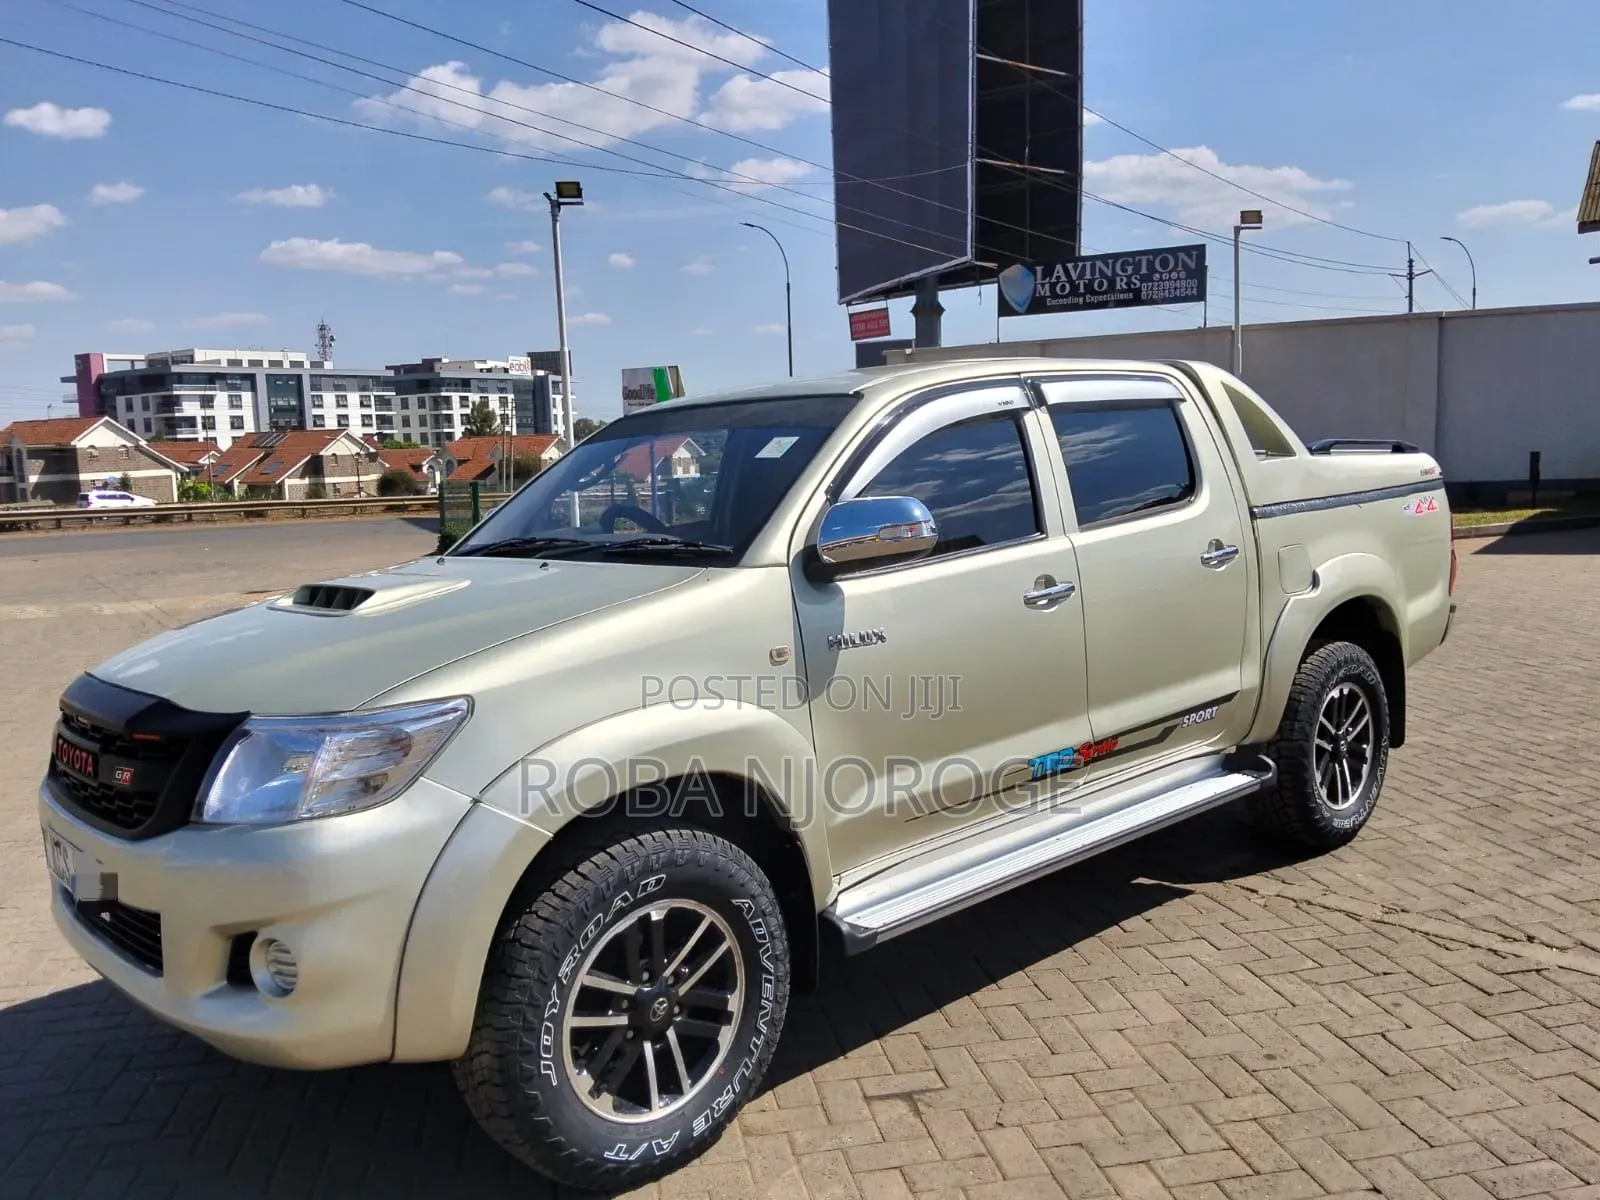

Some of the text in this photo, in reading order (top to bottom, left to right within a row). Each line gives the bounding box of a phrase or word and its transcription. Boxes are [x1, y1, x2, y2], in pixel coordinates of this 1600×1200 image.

[1035, 252, 1198, 284] LAVINGTON
[1036, 275, 1141, 296] MOTORS
[827, 629, 887, 651] HILUX
[1182, 706, 1219, 728] SPORT
[58, 739, 94, 777] TOYOTA
[540, 874, 777, 1161] JOYROAD ADVENTURE A/T
